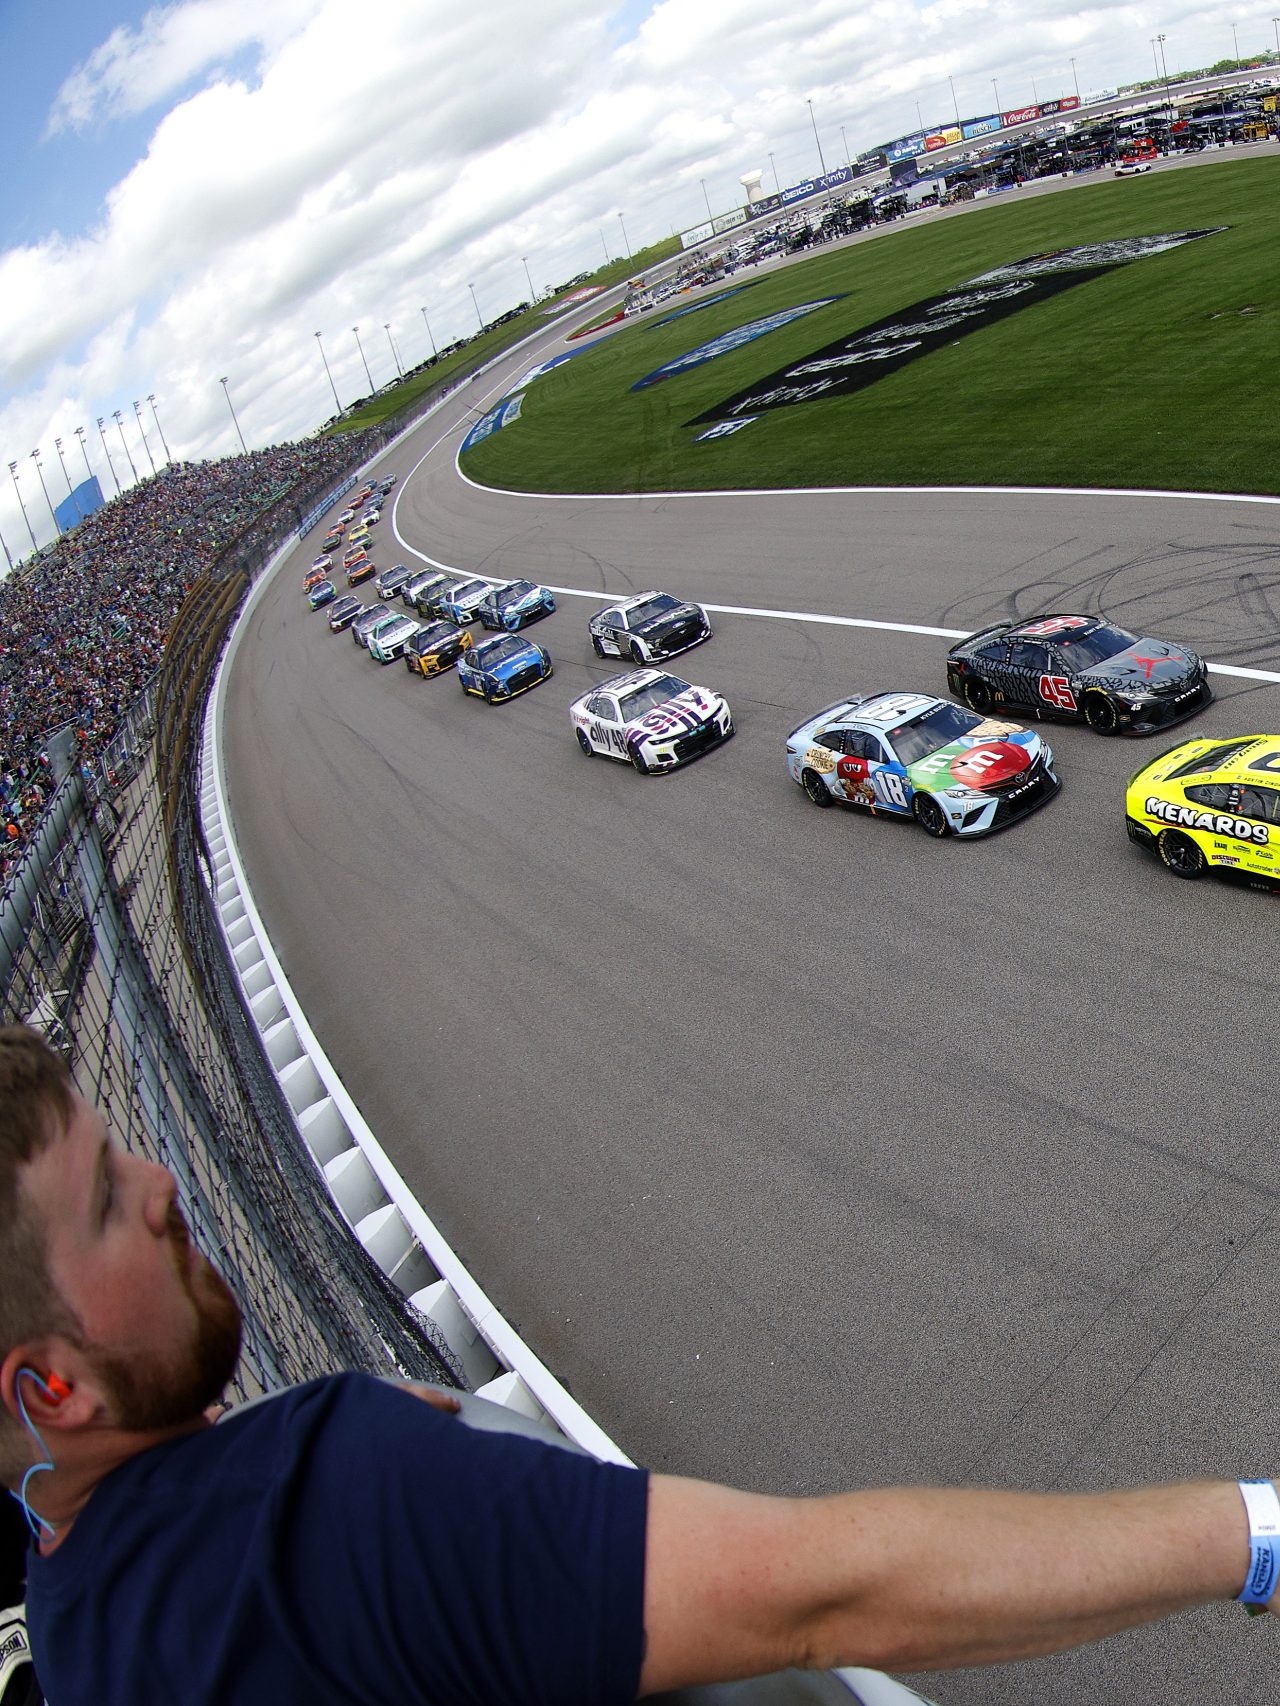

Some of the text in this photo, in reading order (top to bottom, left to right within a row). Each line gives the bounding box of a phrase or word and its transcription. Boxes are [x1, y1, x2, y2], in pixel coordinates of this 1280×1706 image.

[819, 170, 848, 187] xfinity
[782, 183, 814, 201] GEICO
[1039, 675, 1077, 711] 45
[1174, 685, 1201, 703] CAMRY
[1131, 703, 1142, 711] 45
[875, 770, 909, 808] 18
[1008, 776, 1041, 799] CAMRY
[962, 801, 975, 812] 18
[1146, 797, 1269, 844] MENARDS
